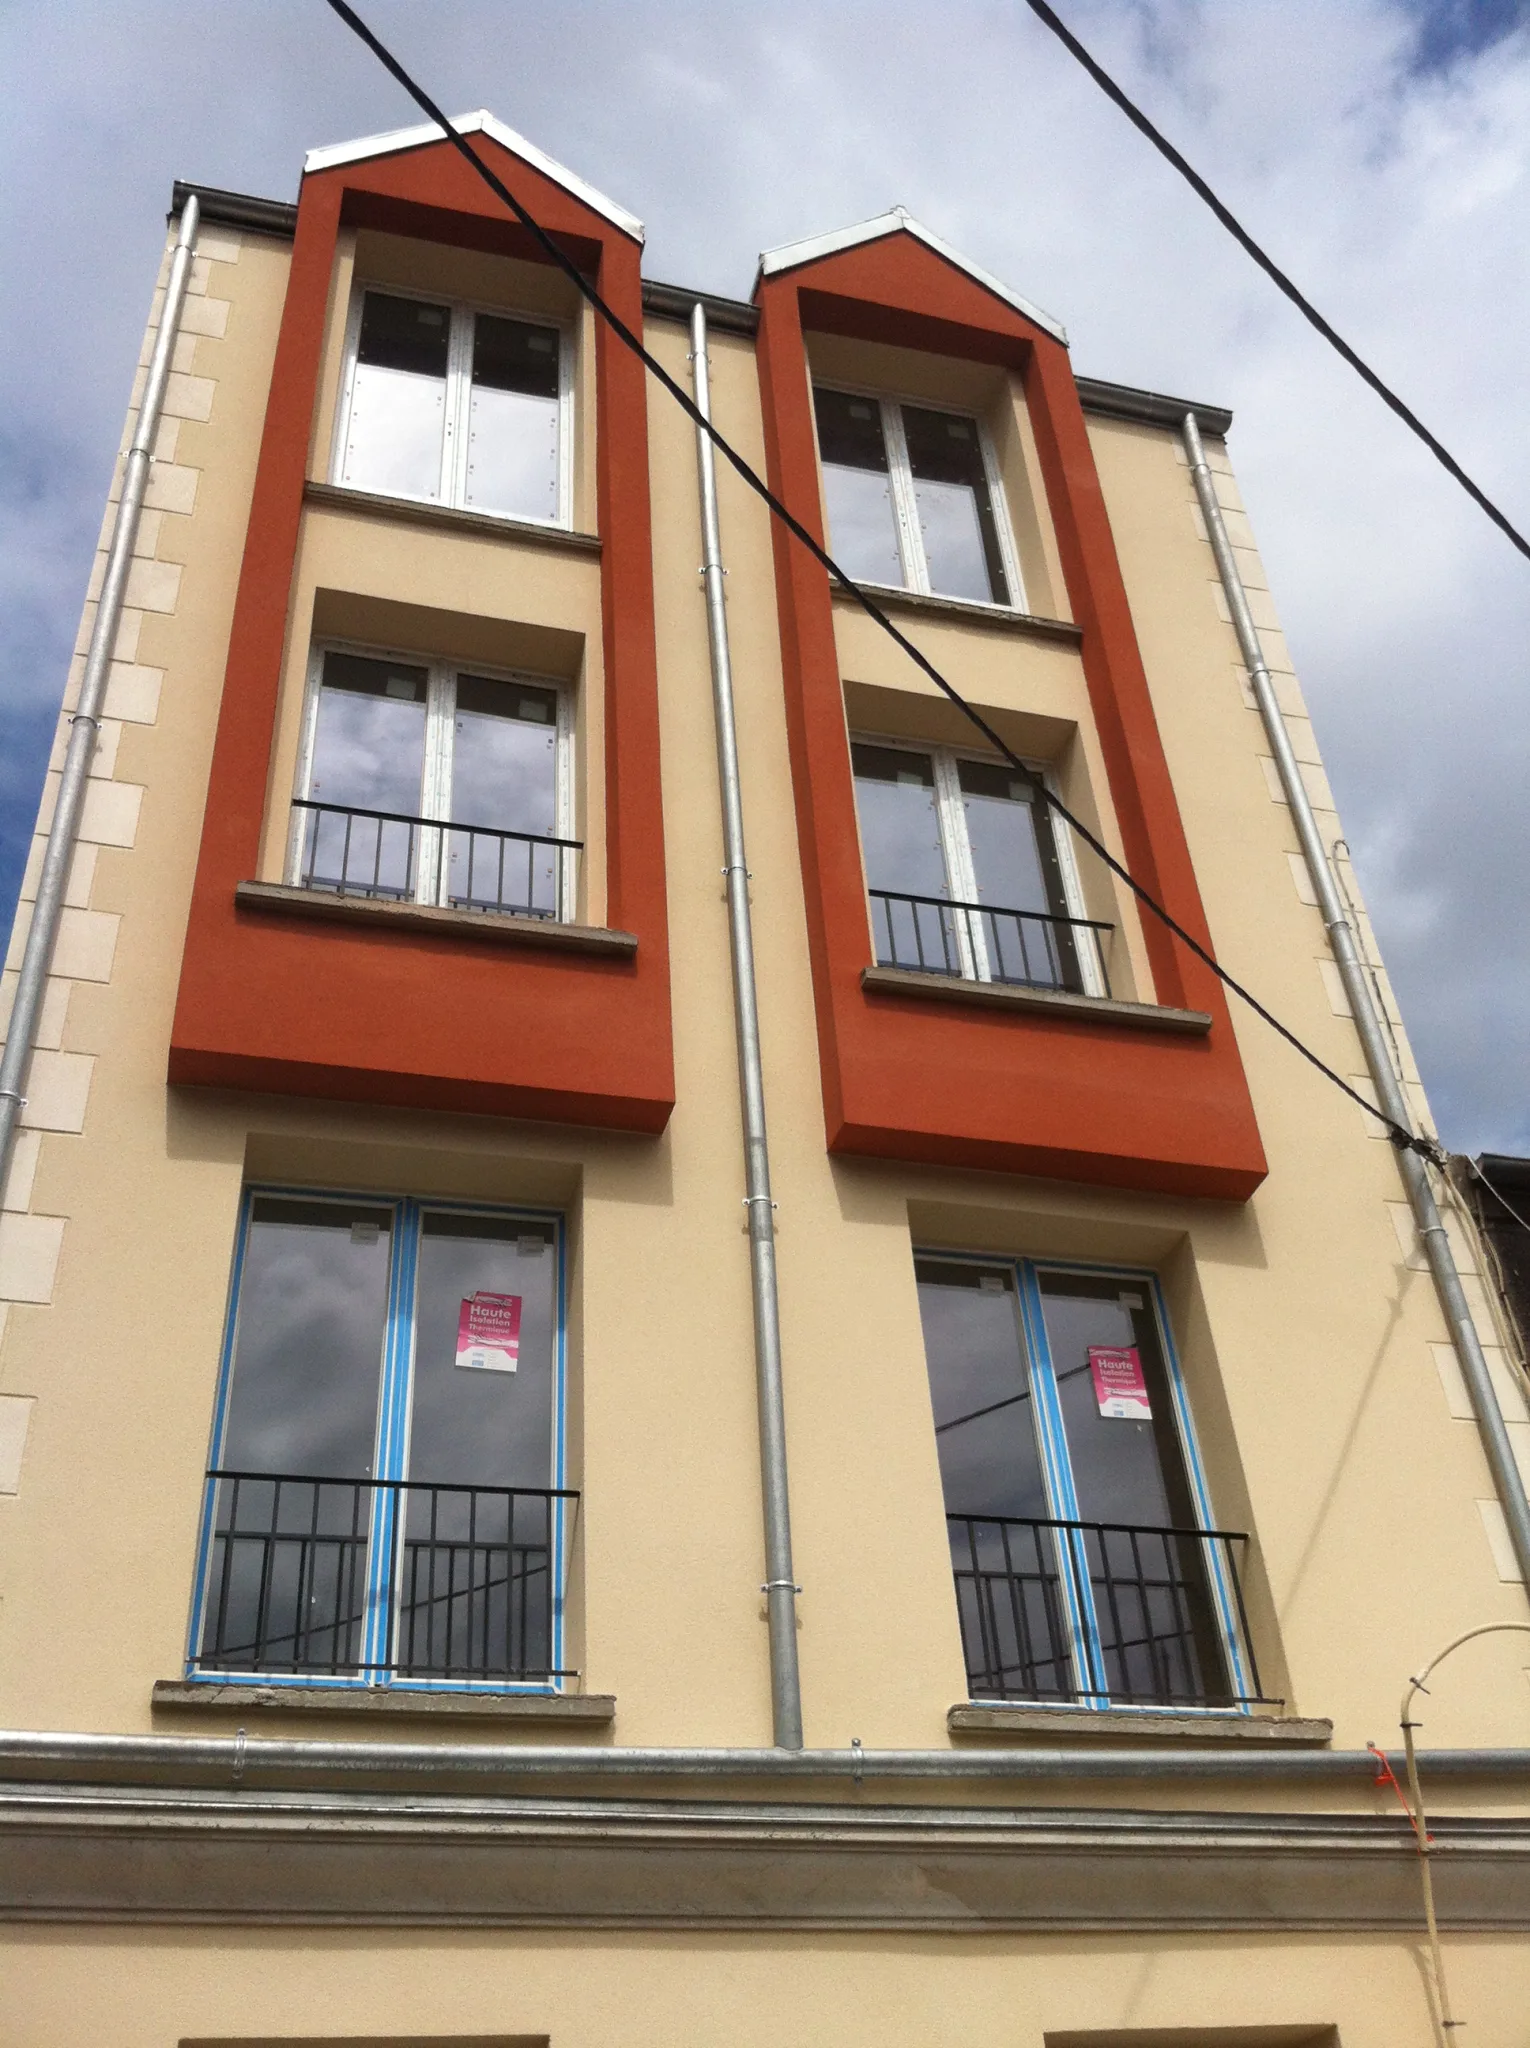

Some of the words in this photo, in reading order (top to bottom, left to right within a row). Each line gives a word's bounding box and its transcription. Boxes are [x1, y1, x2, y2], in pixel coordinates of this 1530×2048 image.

[470, 1304, 511, 1319] Haute
[469, 1315, 510, 1326] Isolation
[468, 1323, 509, 1334] Thermique
[1097, 1359, 1133, 1370] Haute
